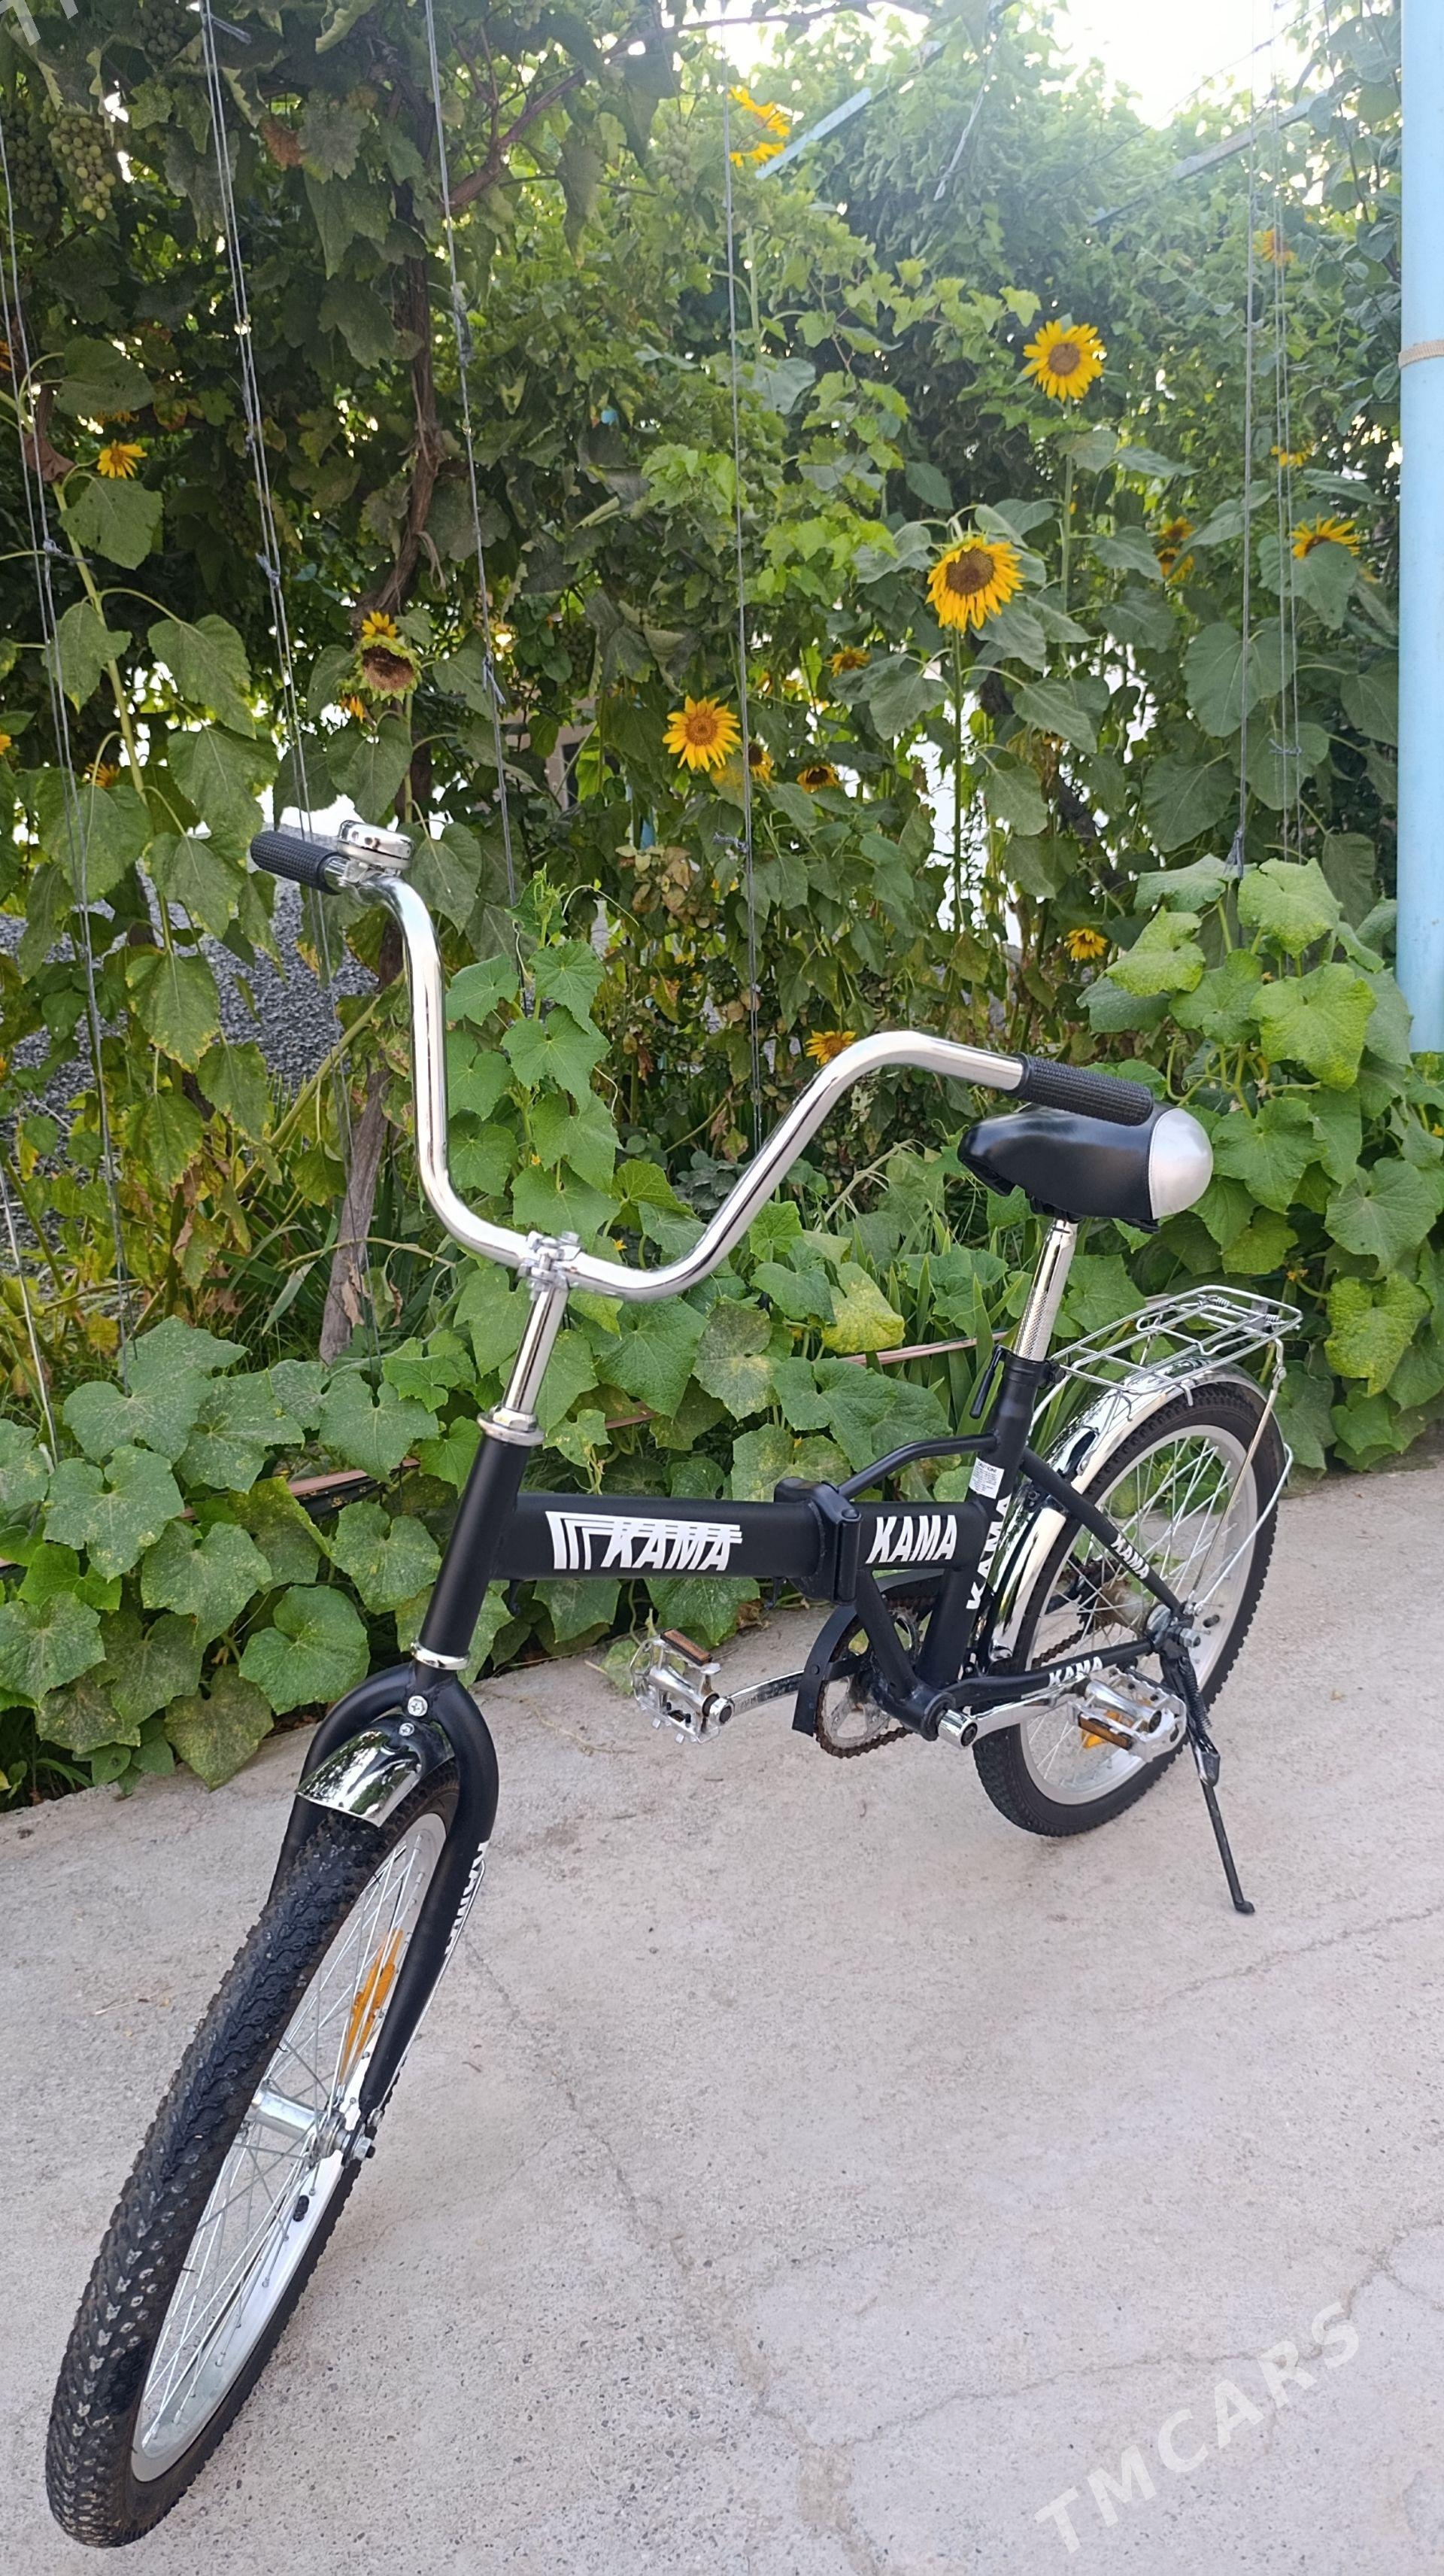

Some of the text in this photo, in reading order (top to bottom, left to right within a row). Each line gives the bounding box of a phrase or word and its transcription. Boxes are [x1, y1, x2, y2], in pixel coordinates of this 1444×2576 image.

[599, 1516, 734, 1571] KAMA
[865, 1514, 957, 1564] KAMA
[1110, 1533, 1150, 1579] KAMA
[1048, 1656, 1103, 1687] KAMA
